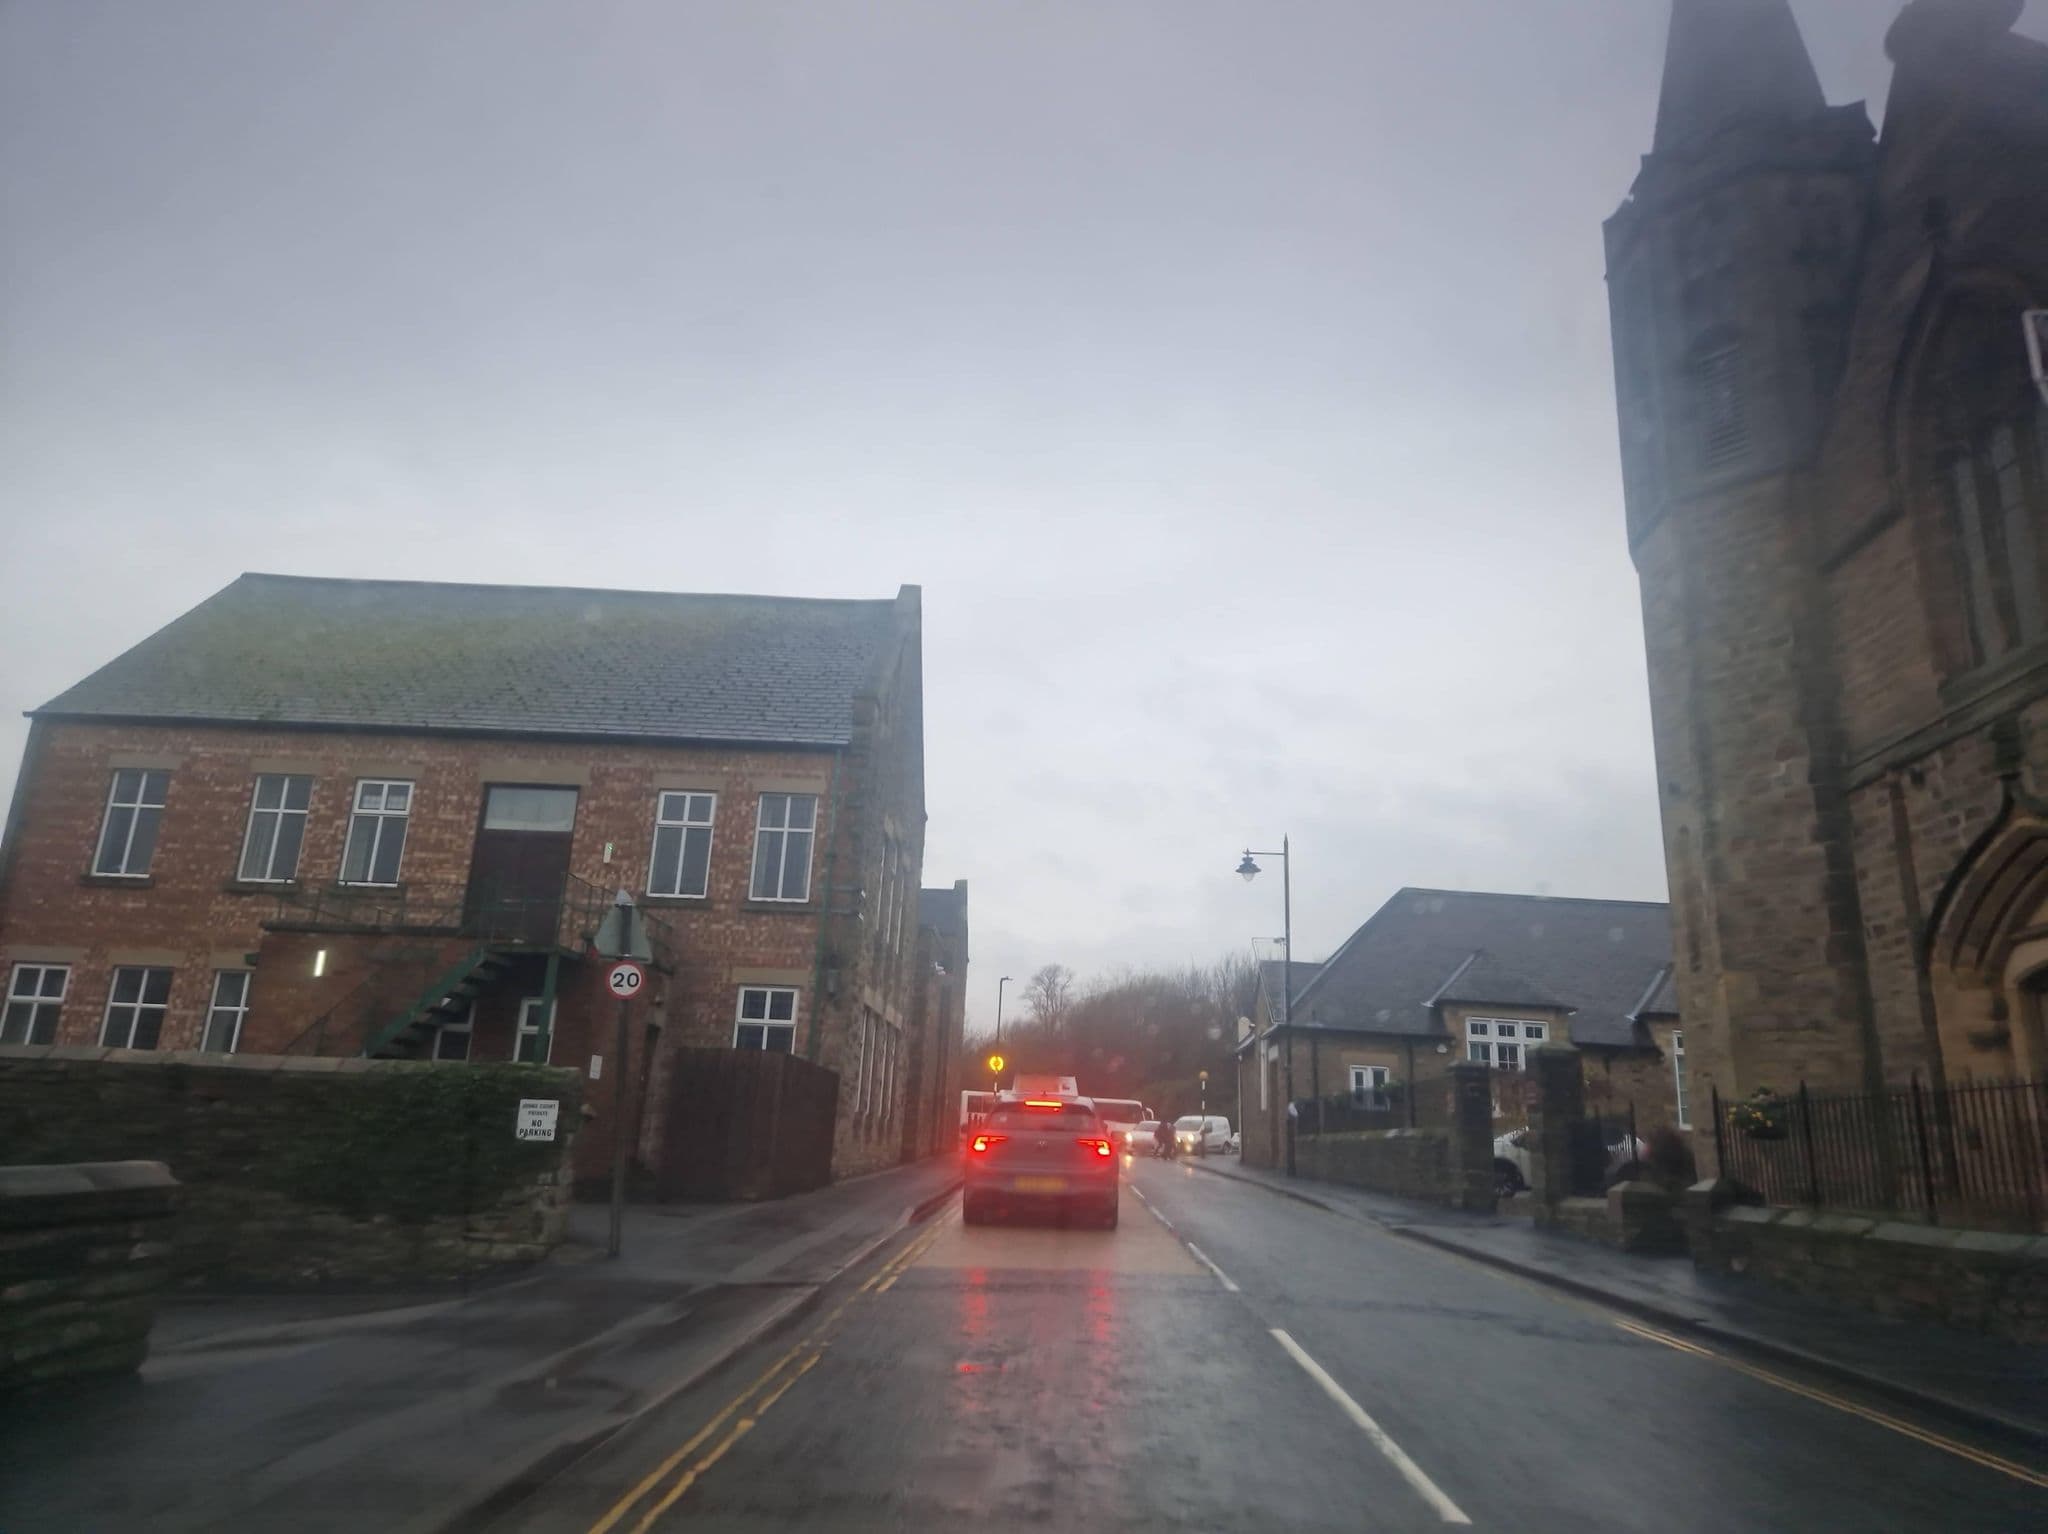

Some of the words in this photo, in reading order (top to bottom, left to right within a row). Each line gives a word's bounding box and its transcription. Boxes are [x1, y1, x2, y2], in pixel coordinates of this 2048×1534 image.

[613, 972, 639, 988] 20
[531, 1119, 542, 1127] NO
[519, 1128, 552, 1137] PARKING
